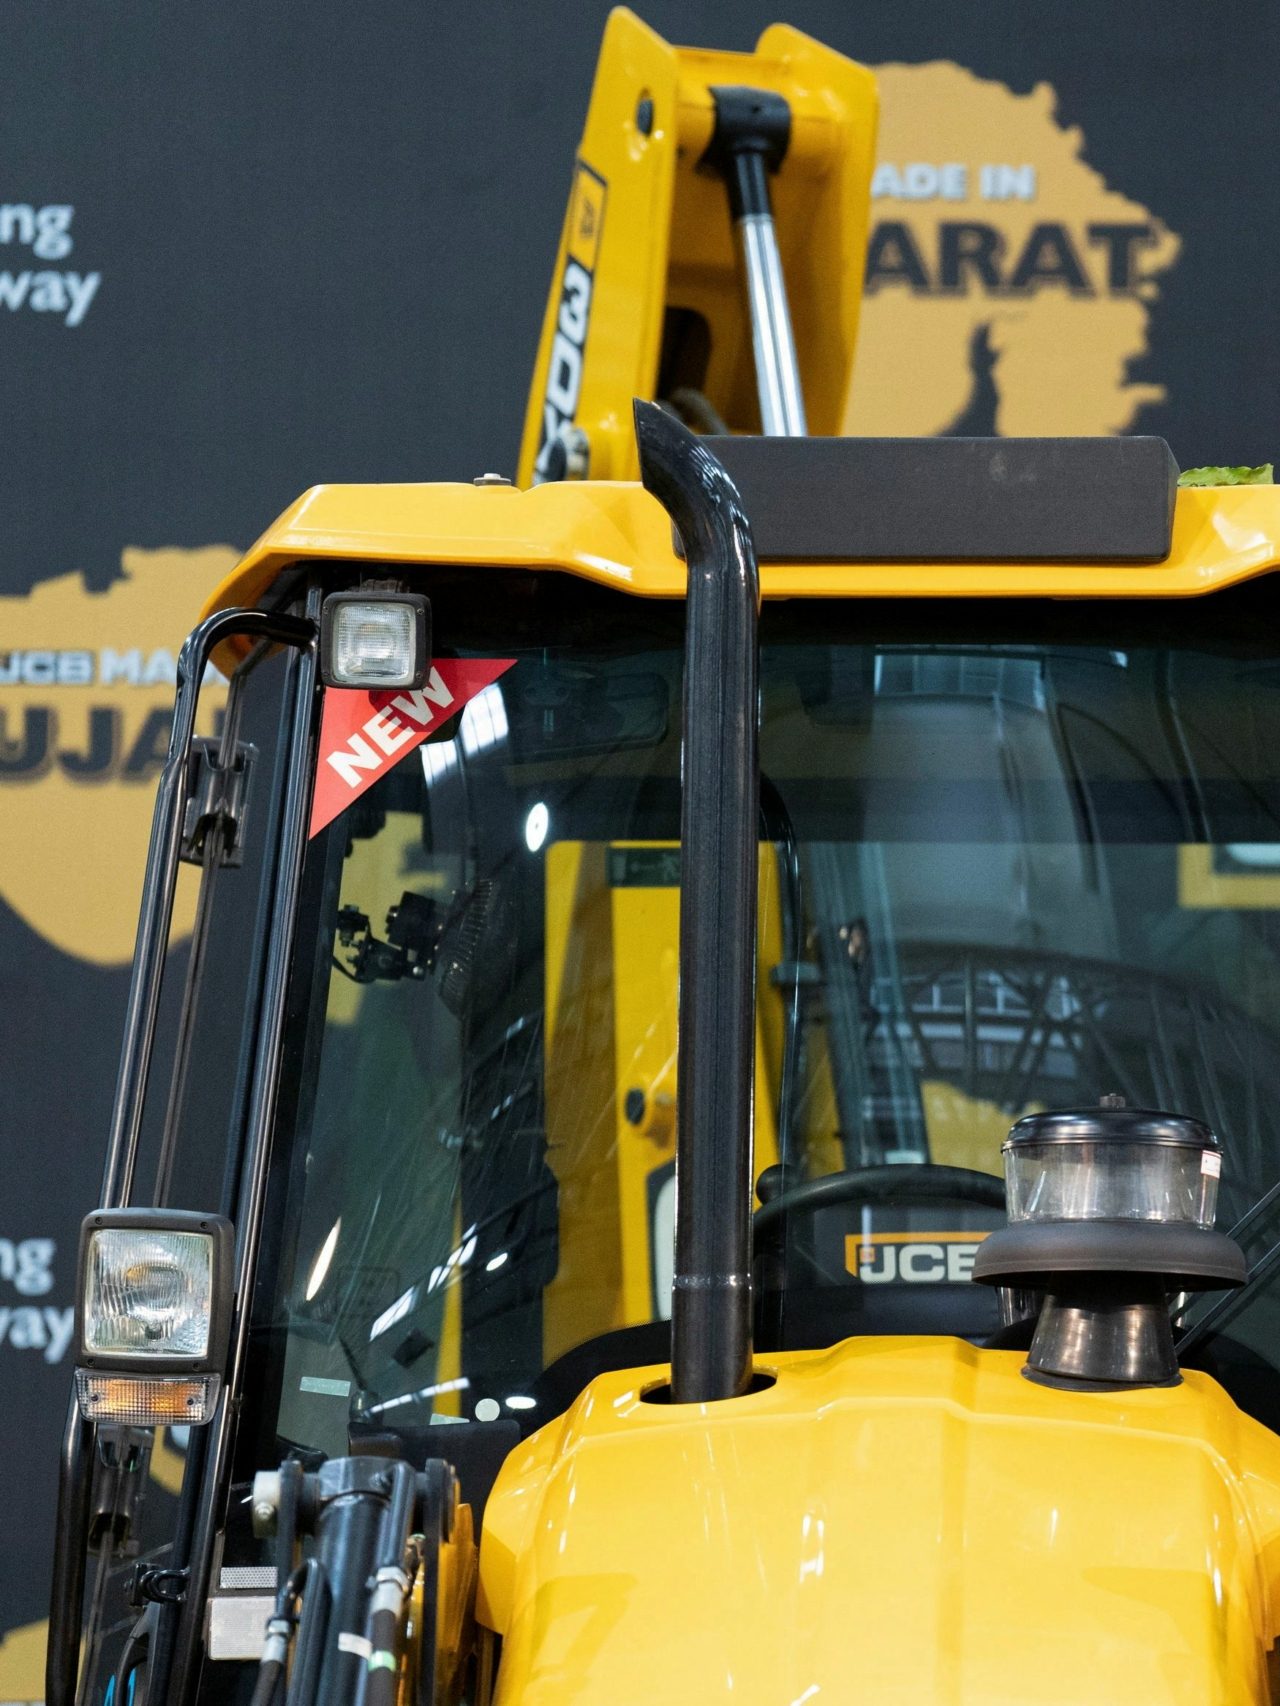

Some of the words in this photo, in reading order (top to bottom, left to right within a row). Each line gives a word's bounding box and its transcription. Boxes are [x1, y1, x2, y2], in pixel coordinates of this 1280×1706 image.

[979, 164, 1036, 201] IN
[326, 666, 455, 790] NEW
[0, 1306, 75, 1364] ay
